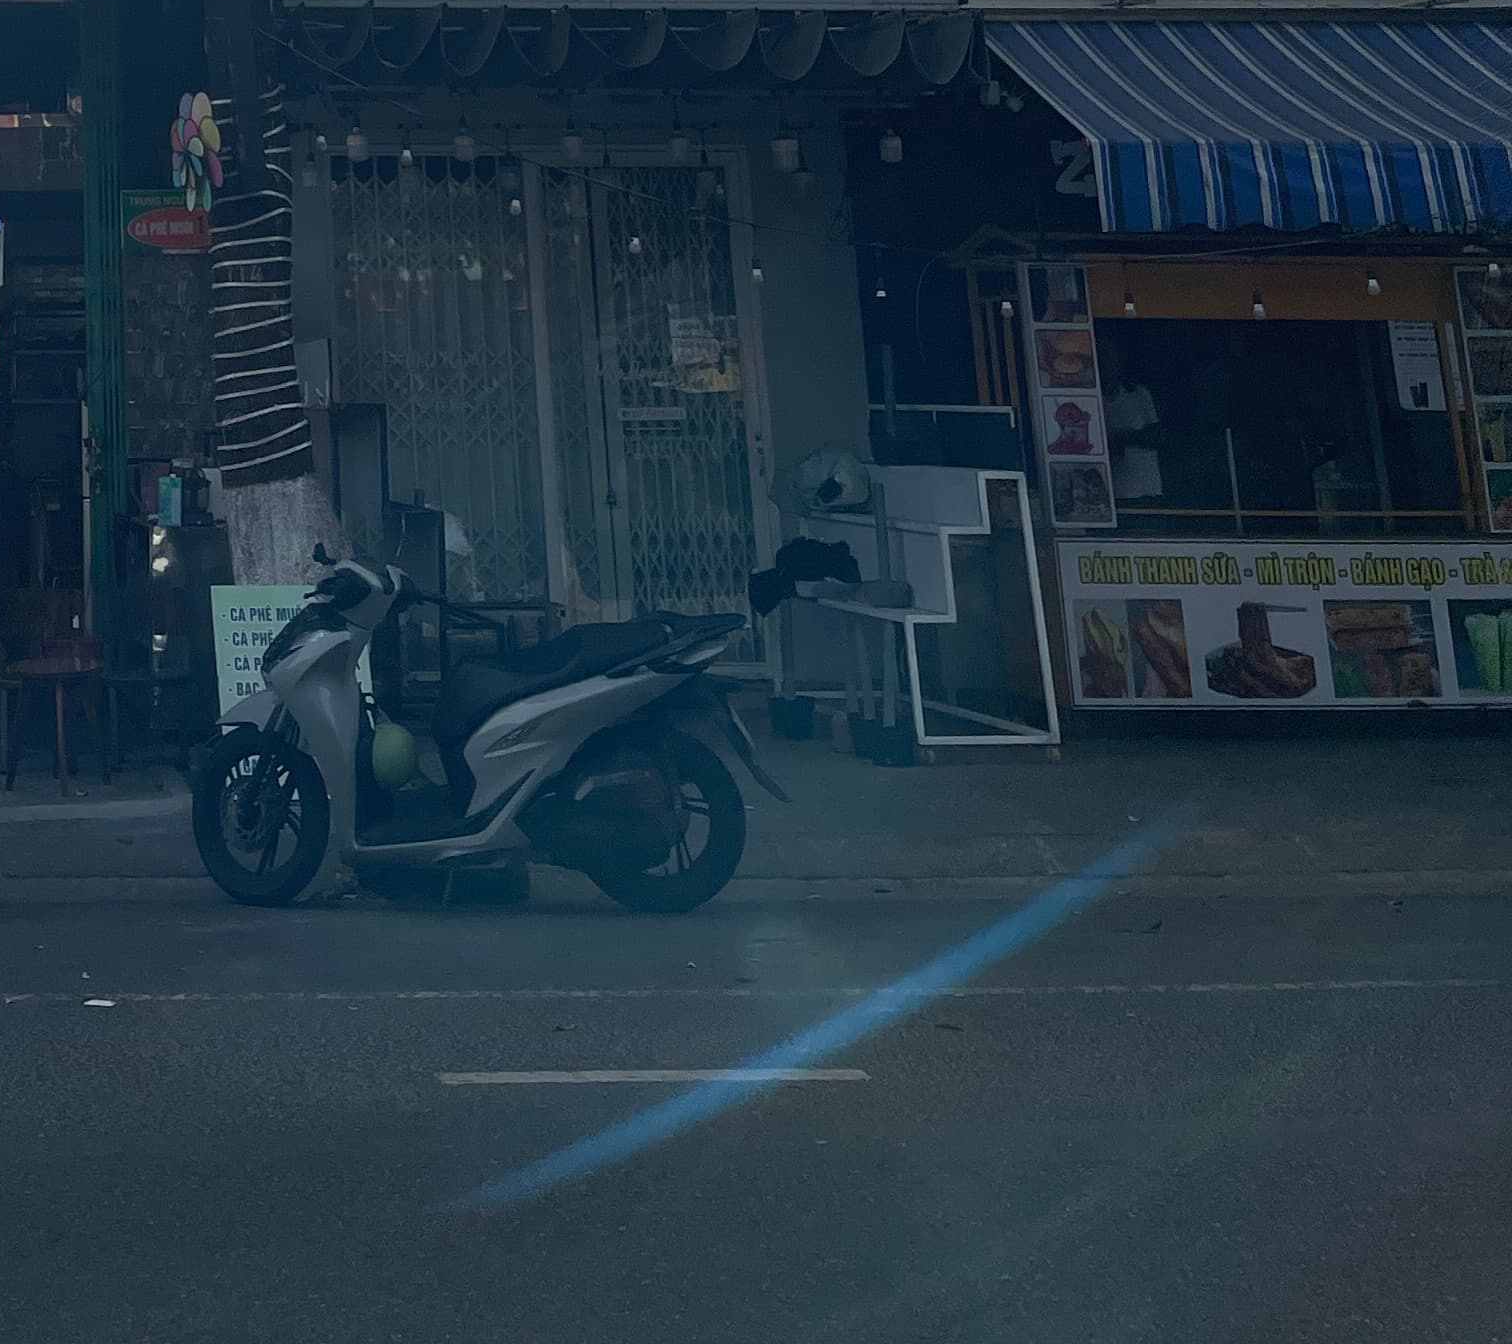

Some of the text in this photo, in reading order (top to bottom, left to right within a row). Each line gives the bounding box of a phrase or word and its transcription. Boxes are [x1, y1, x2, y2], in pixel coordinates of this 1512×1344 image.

[1078, 550, 1133, 585] BÁNH
[1136, 555, 1199, 585] THANH
[1201, 551, 1240, 585] SỮA
[1255, 551, 1282, 585] MÌ
[1283, 553, 1335, 591] TRỘN
[1350, 550, 1403, 585] BÁNH
[1405, 557, 1445, 591] GẠO
[230, 604, 247, 622] CÀ
[250, 603, 272, 622] PHÊ
[232, 629, 248, 647] CÀ
[234, 654, 251, 672] CÀ
